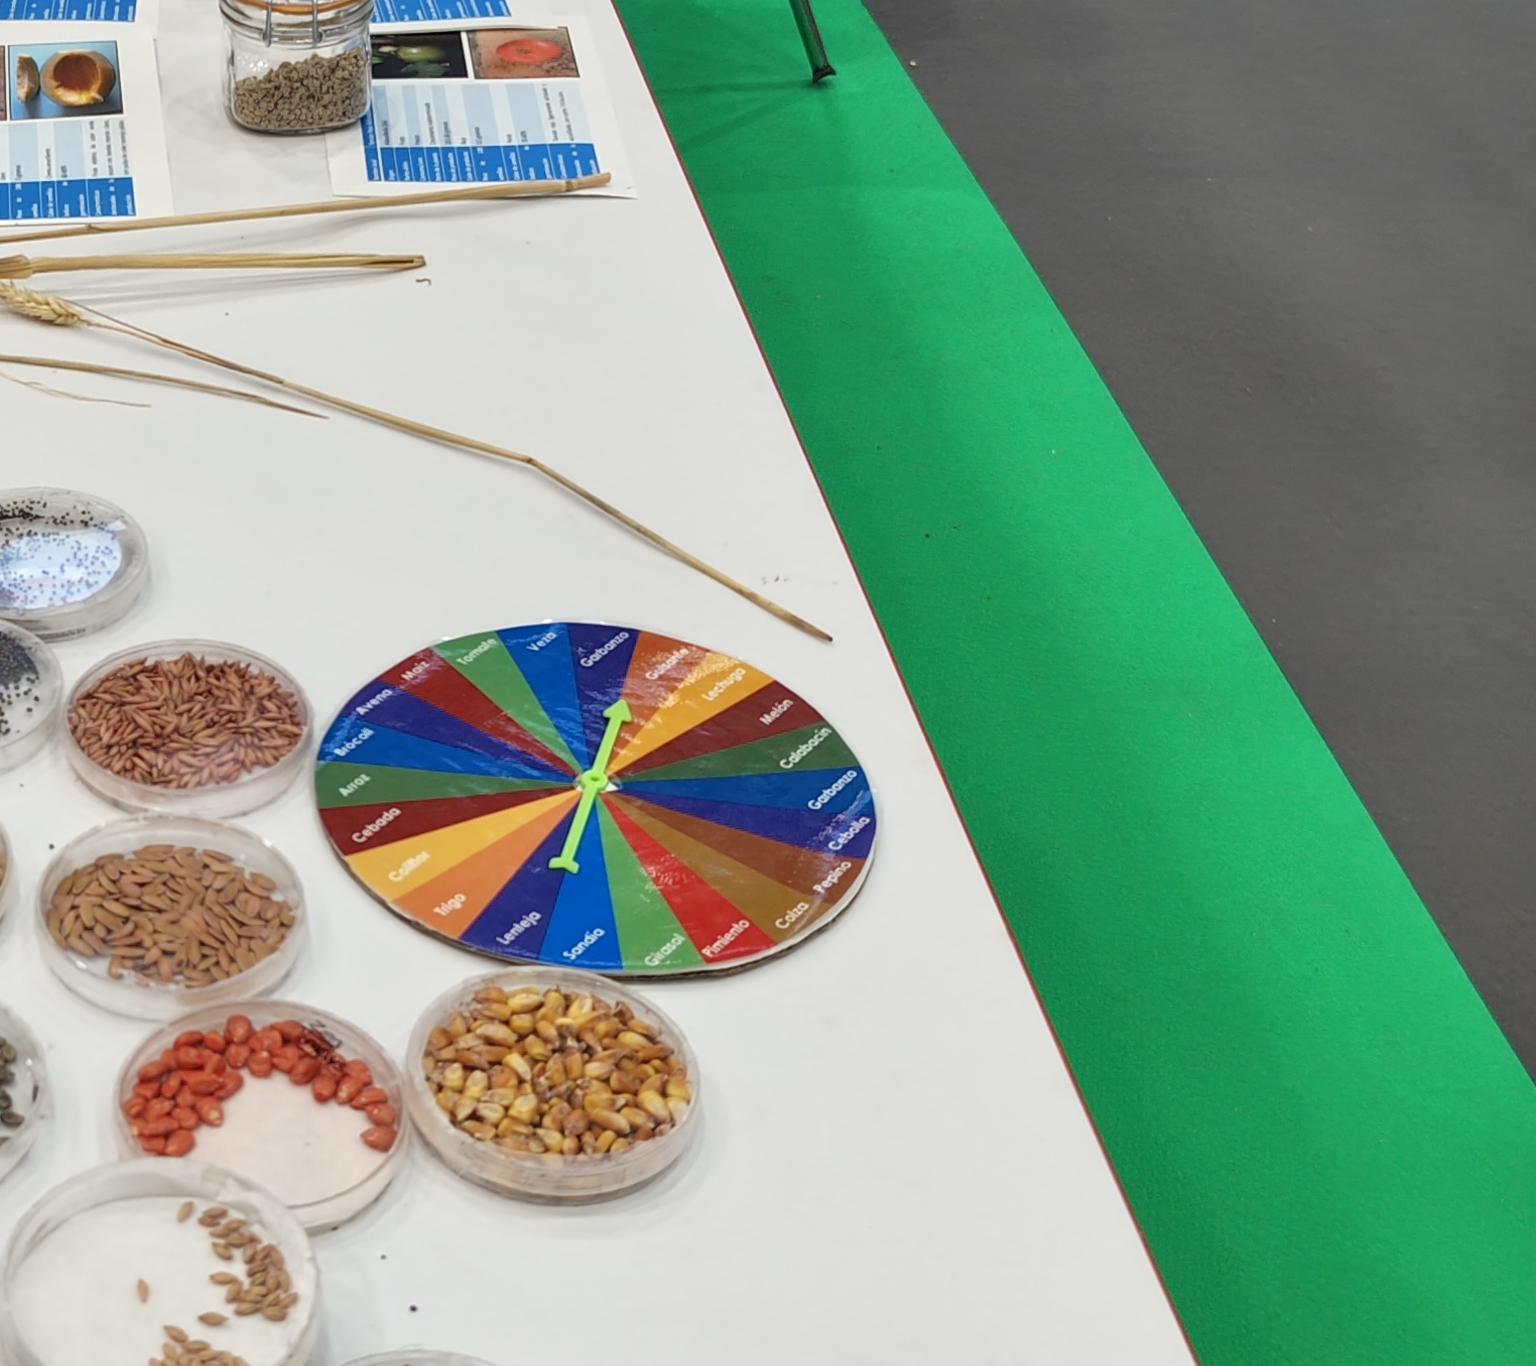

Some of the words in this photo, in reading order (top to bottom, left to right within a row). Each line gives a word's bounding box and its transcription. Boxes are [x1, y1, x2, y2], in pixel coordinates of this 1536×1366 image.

[456, 637, 498, 666] Tomate
[526, 631, 557, 653] Veza
[579, 631, 629, 668] Garbanzo
[701, 666, 747, 701] Lechuga
[355, 687, 393, 716] Avena
[759, 697, 794, 726] Melón
[338, 773, 372, 798] Arroz
[807, 769, 858, 811] Garbanzo
[351, 807, 402, 844] Cebada
[828, 815, 871, 851] Cebolla
[812, 860, 852, 895] Pepino
[433, 891, 467, 918] Trigo
[775, 901, 810, 931] Colza
[496, 910, 542, 946] Lenteja
[701, 918, 751, 959] Pimiento
[644, 933, 686, 967] Girasol
